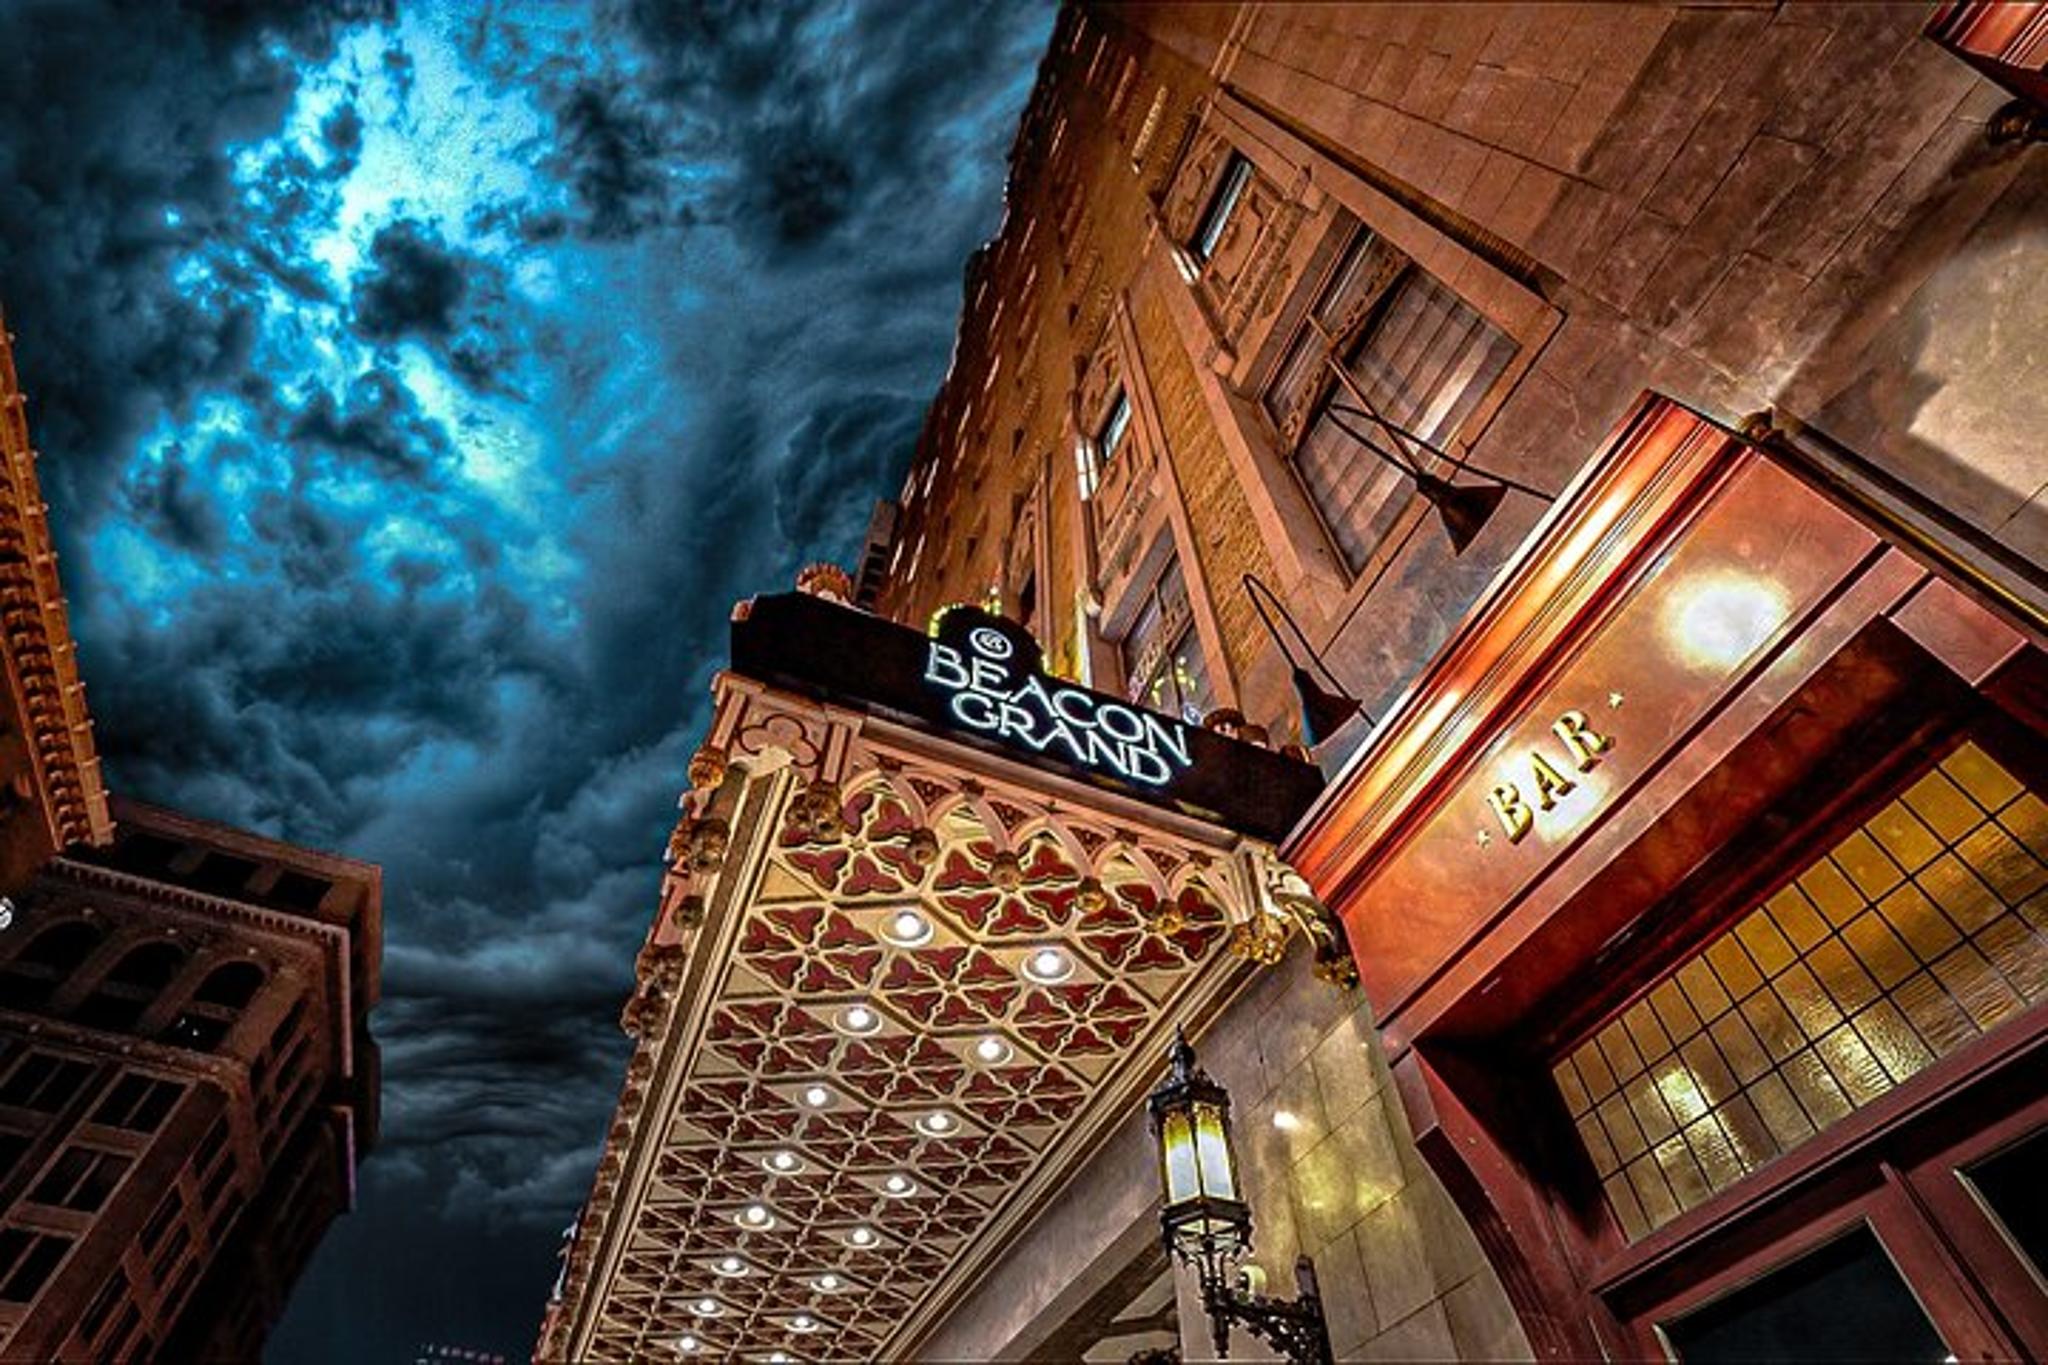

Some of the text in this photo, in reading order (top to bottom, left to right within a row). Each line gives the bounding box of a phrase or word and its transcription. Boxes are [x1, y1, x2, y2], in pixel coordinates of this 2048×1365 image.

[925, 644, 1192, 766] BEACON
[952, 692, 1172, 784] GRAND
[1487, 709, 1615, 845] BAR
